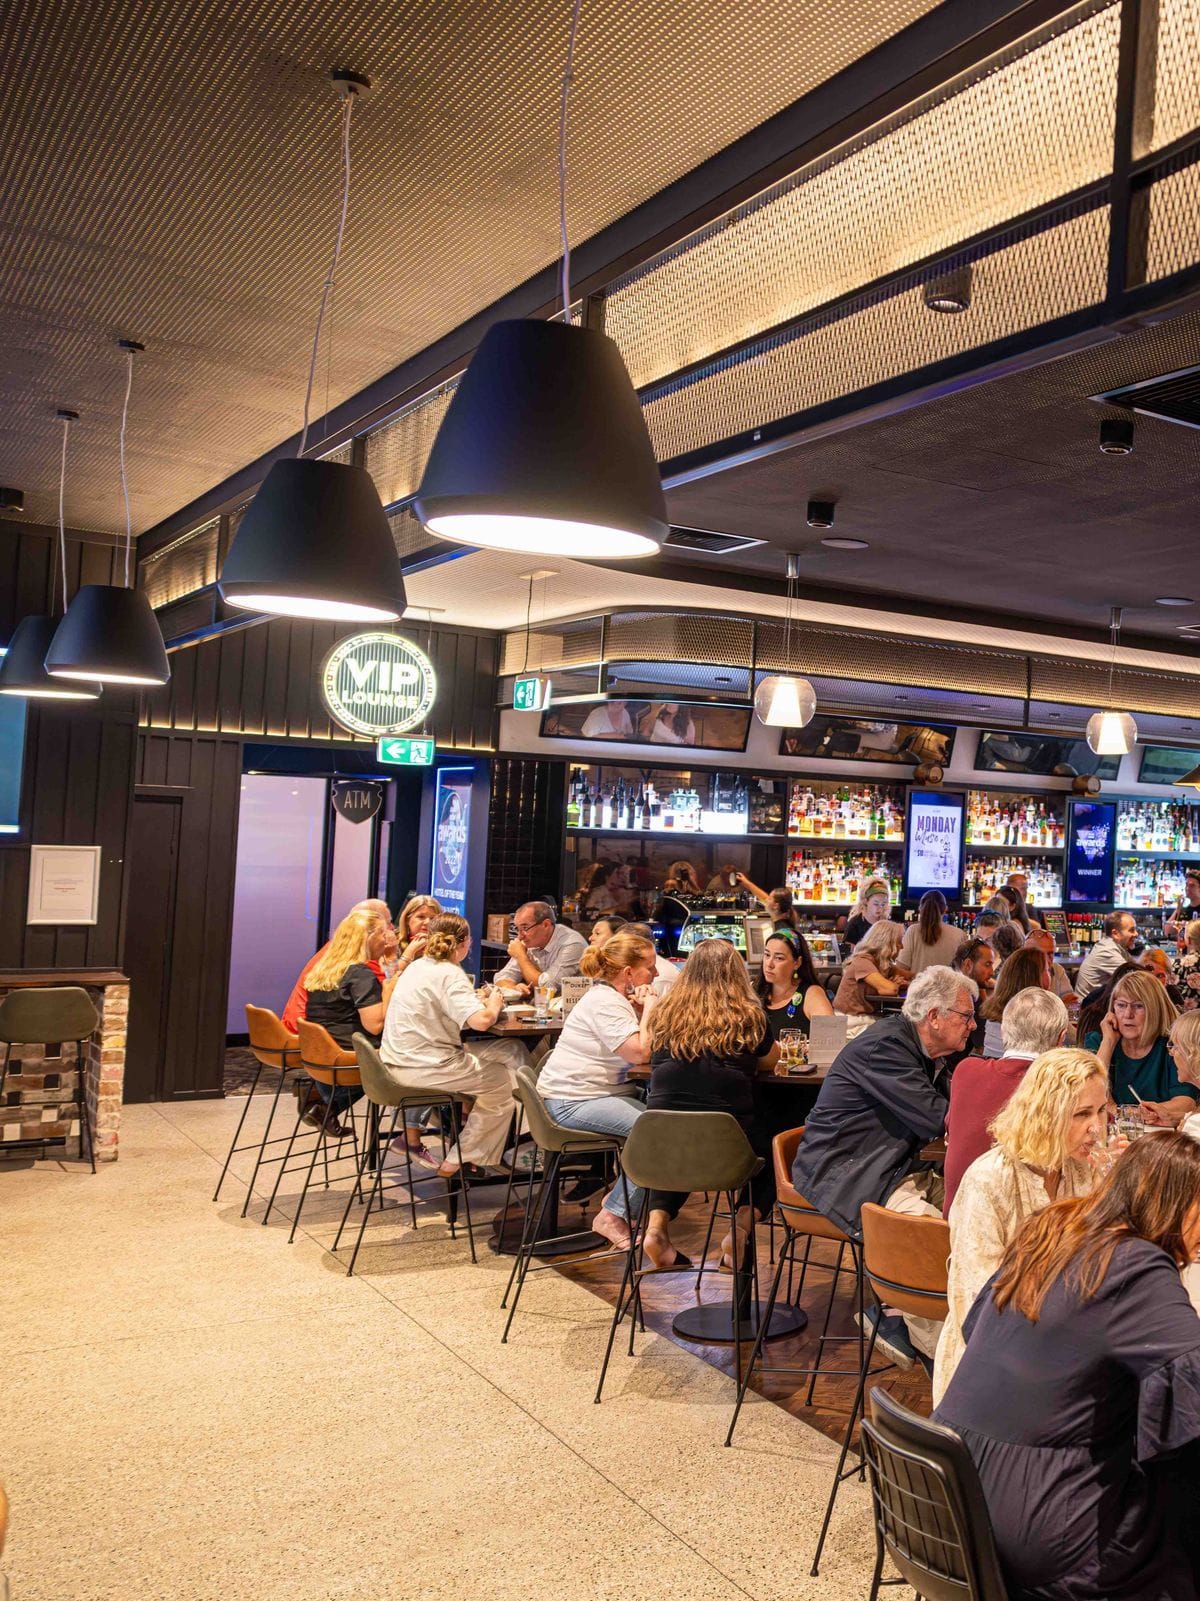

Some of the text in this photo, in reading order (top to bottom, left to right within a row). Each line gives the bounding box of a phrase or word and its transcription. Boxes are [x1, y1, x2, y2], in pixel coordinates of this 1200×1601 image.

[346, 658, 419, 692] VIP
[342, 690, 419, 709] LOUNGE
[344, 790, 370, 808] ATM
[917, 815, 956, 833] MONDAY
[1076, 838, 1106, 847] awards
[1077, 868, 1102, 876] WINNER
